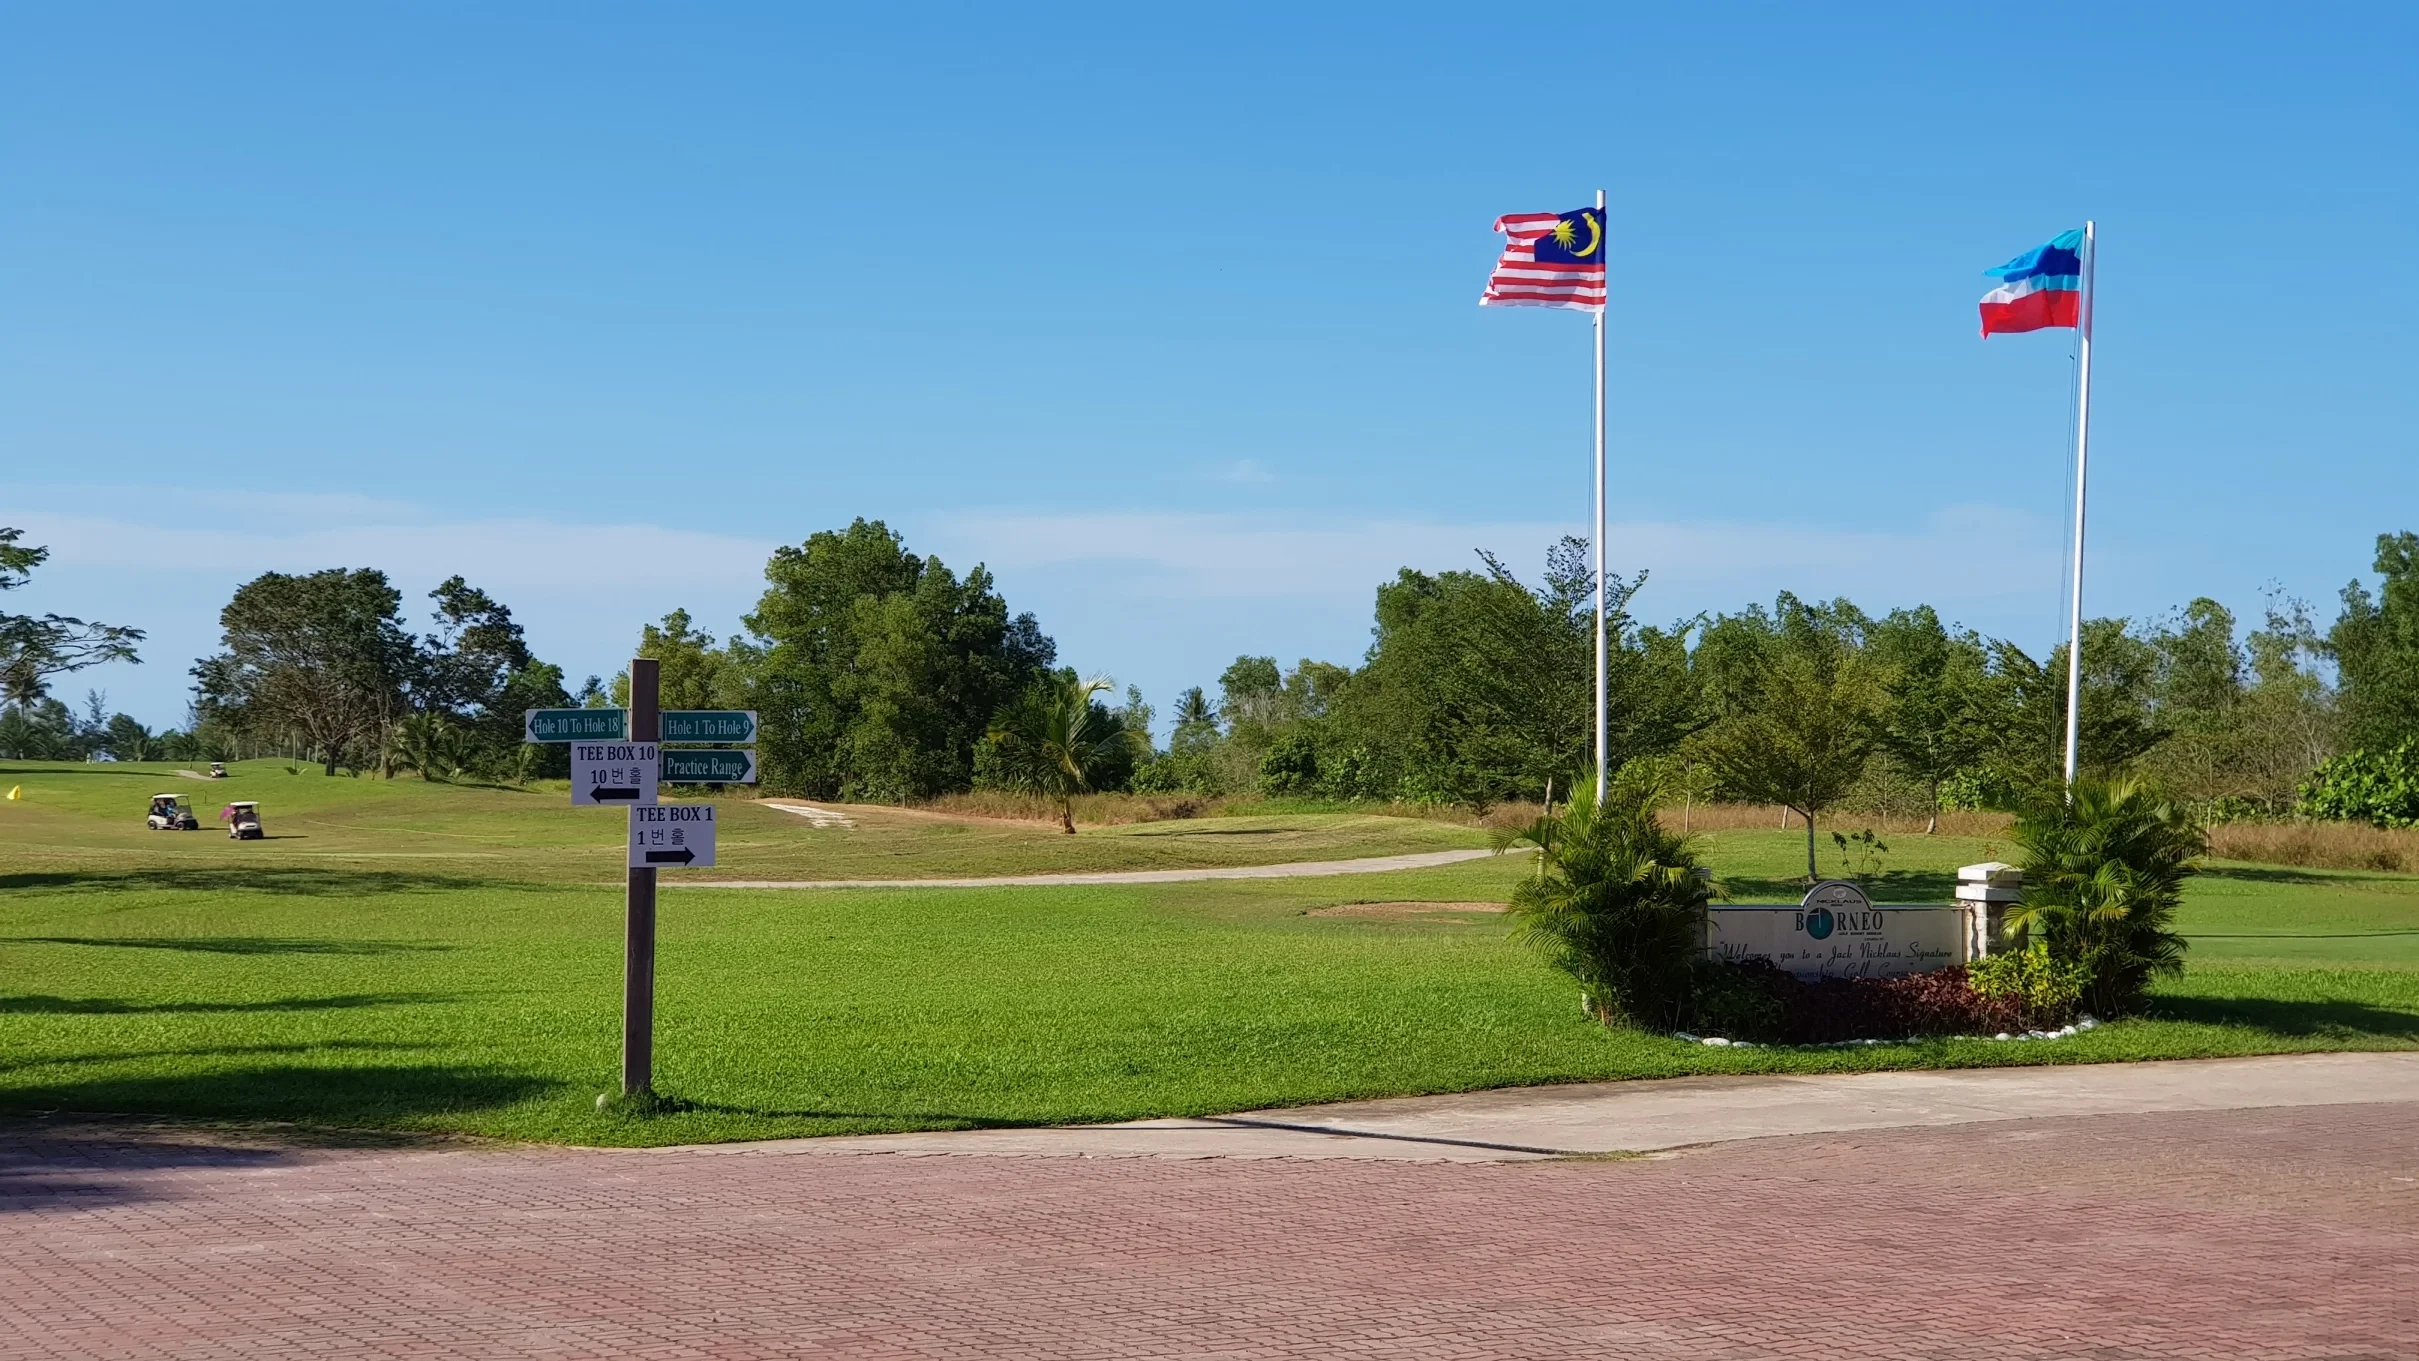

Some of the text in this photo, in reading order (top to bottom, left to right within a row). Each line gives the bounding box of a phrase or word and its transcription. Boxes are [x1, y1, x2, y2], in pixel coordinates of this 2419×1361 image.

[534, 717, 619, 734] Hole 10 To Hole 18
[668, 720, 750, 735] Hole 1 To Hole 9
[577, 745, 655, 761] TEE BOX 10
[591, 766, 642, 785] 10 번 홀
[667, 758, 743, 780] Practice Range
[636, 807, 713, 822] TEE BOX 1
[637, 828, 685, 846] 1 번 홀
[1780, 952, 1795, 963] you
[1802, 949, 1811, 959] to
[1826, 945, 1853, 967] Jack
[1860, 941, 1901, 959] Nicklaus
[1904, 941, 1952, 962] Signature
